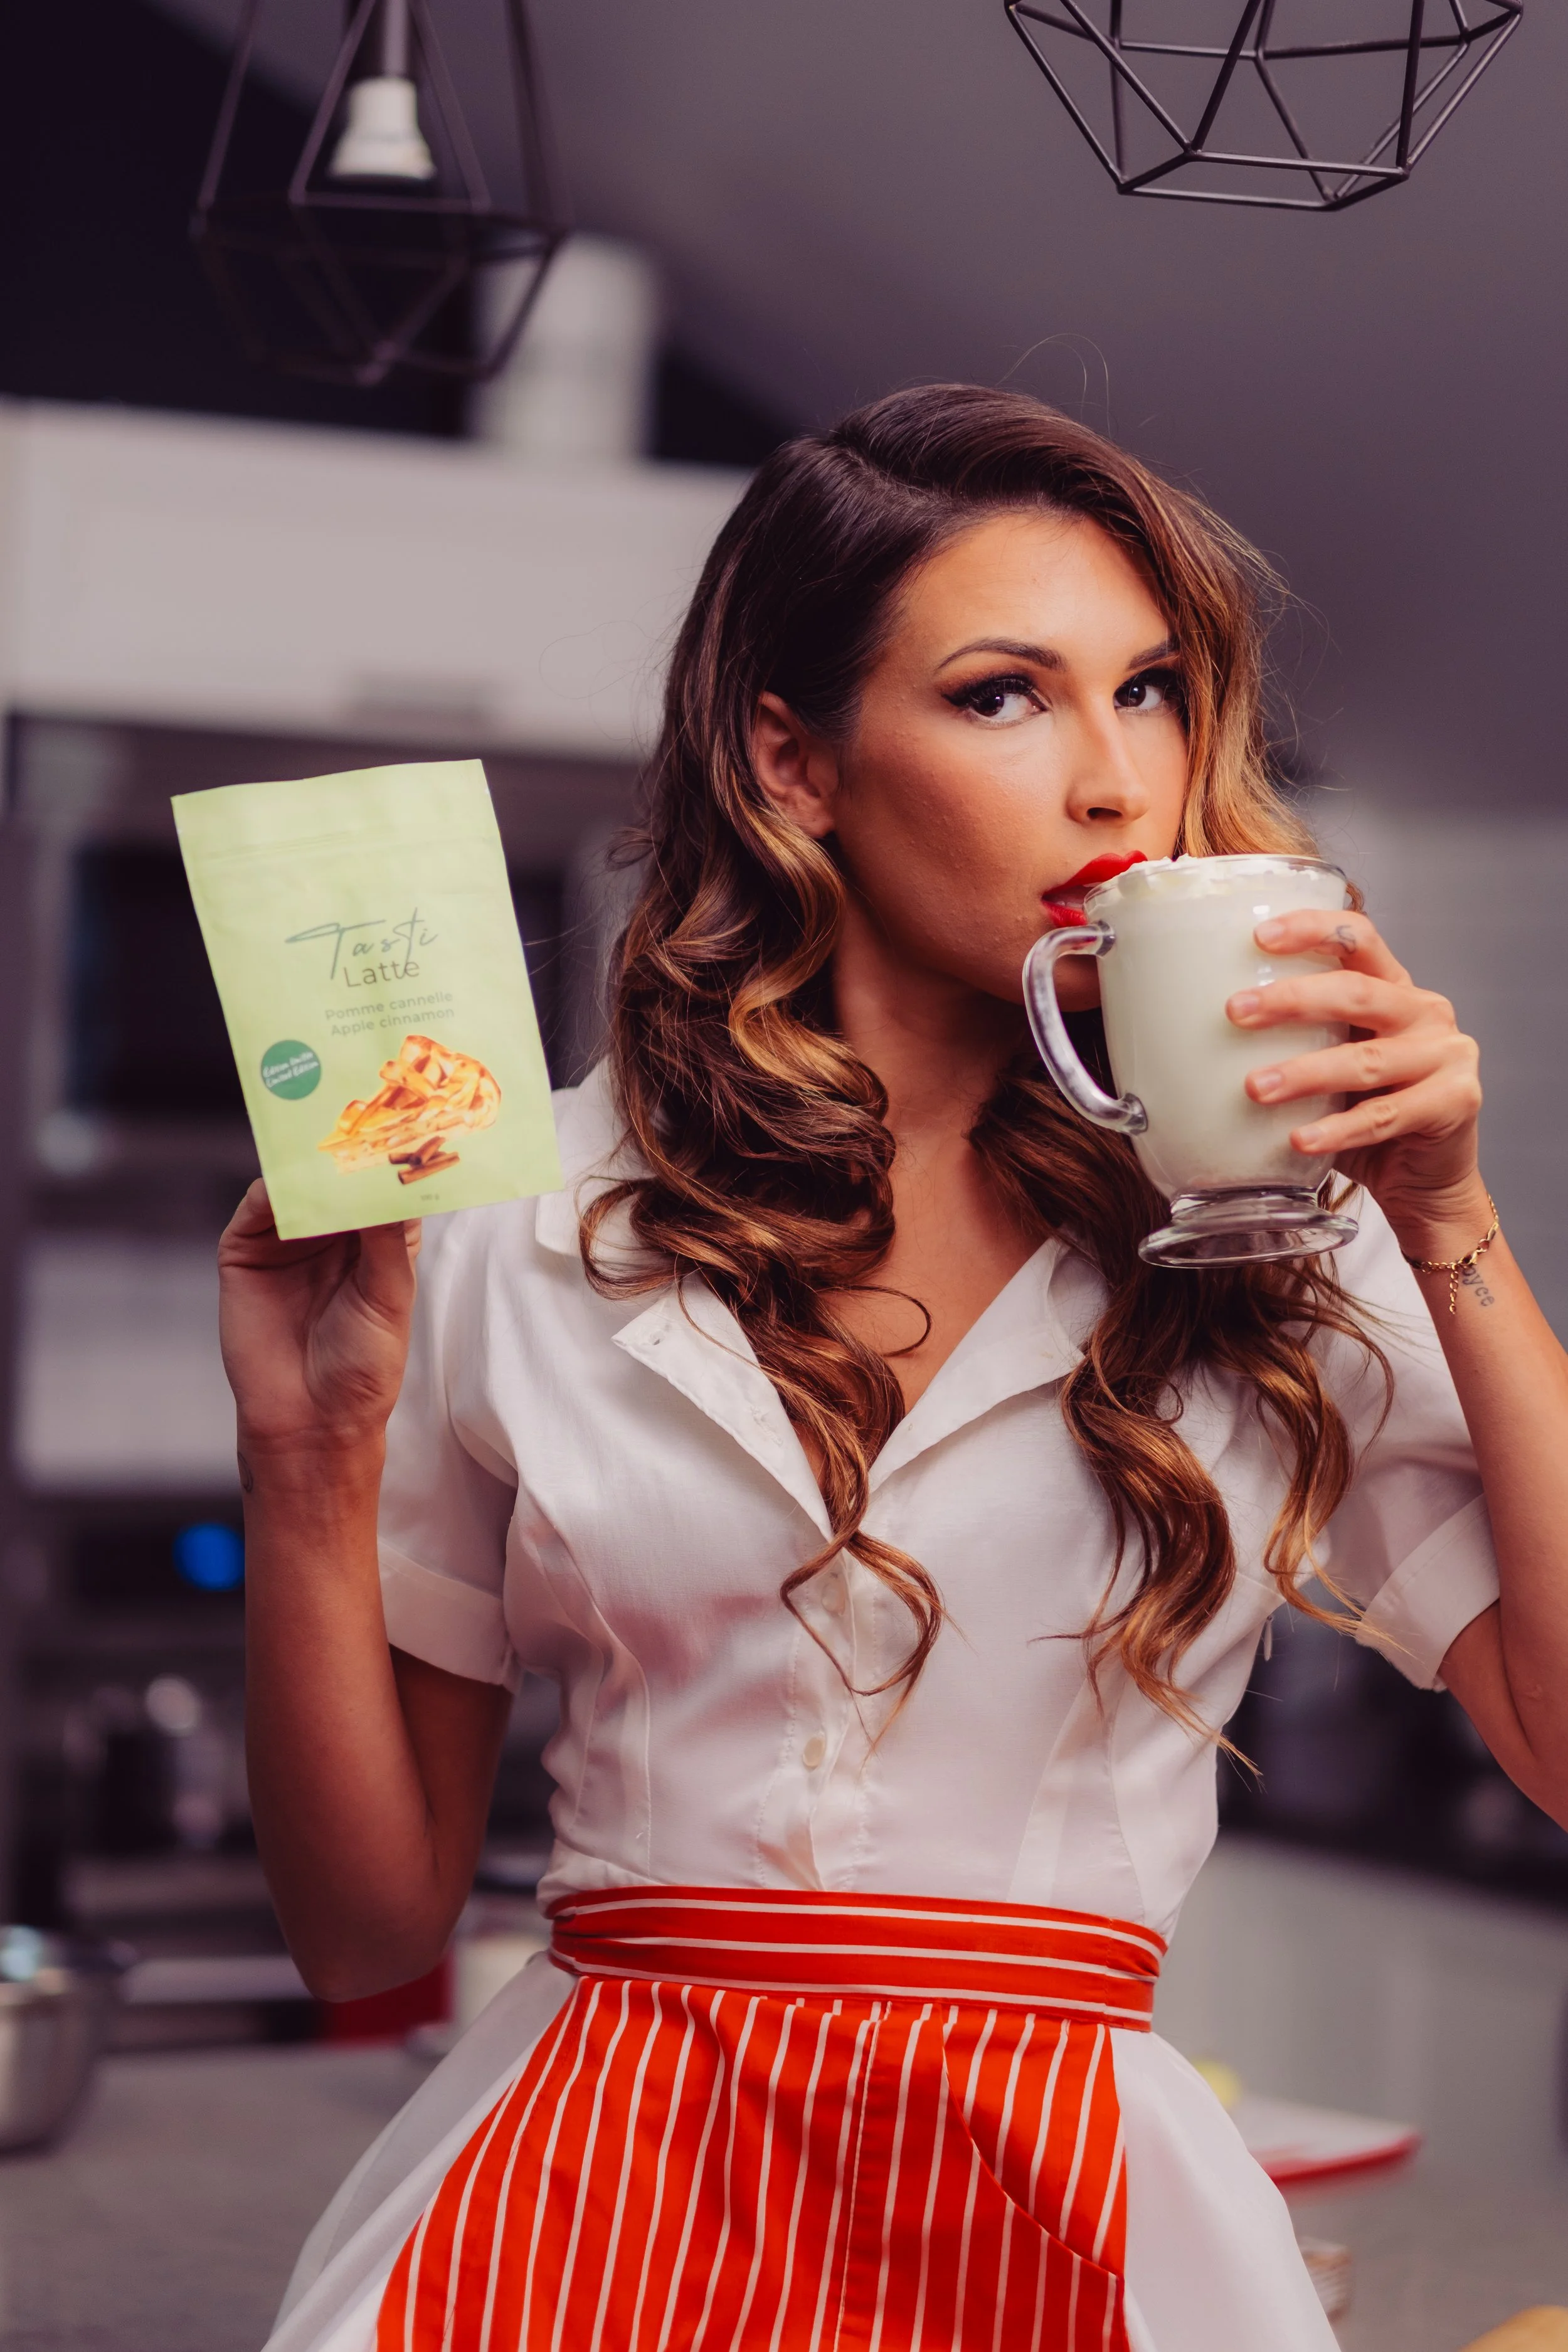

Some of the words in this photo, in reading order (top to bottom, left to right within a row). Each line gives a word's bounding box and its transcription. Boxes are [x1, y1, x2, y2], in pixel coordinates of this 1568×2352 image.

[284, 907, 438, 980] Tasti
[344, 961, 420, 988] Latte
[325, 1004, 384, 1021] Pomme
[389, 991, 453, 1010] cannelle
[331, 1020, 375, 1037] Apple
[379, 1007, 455, 1029] cinnamon
[1461, 1266, 1495, 1306] oyce
